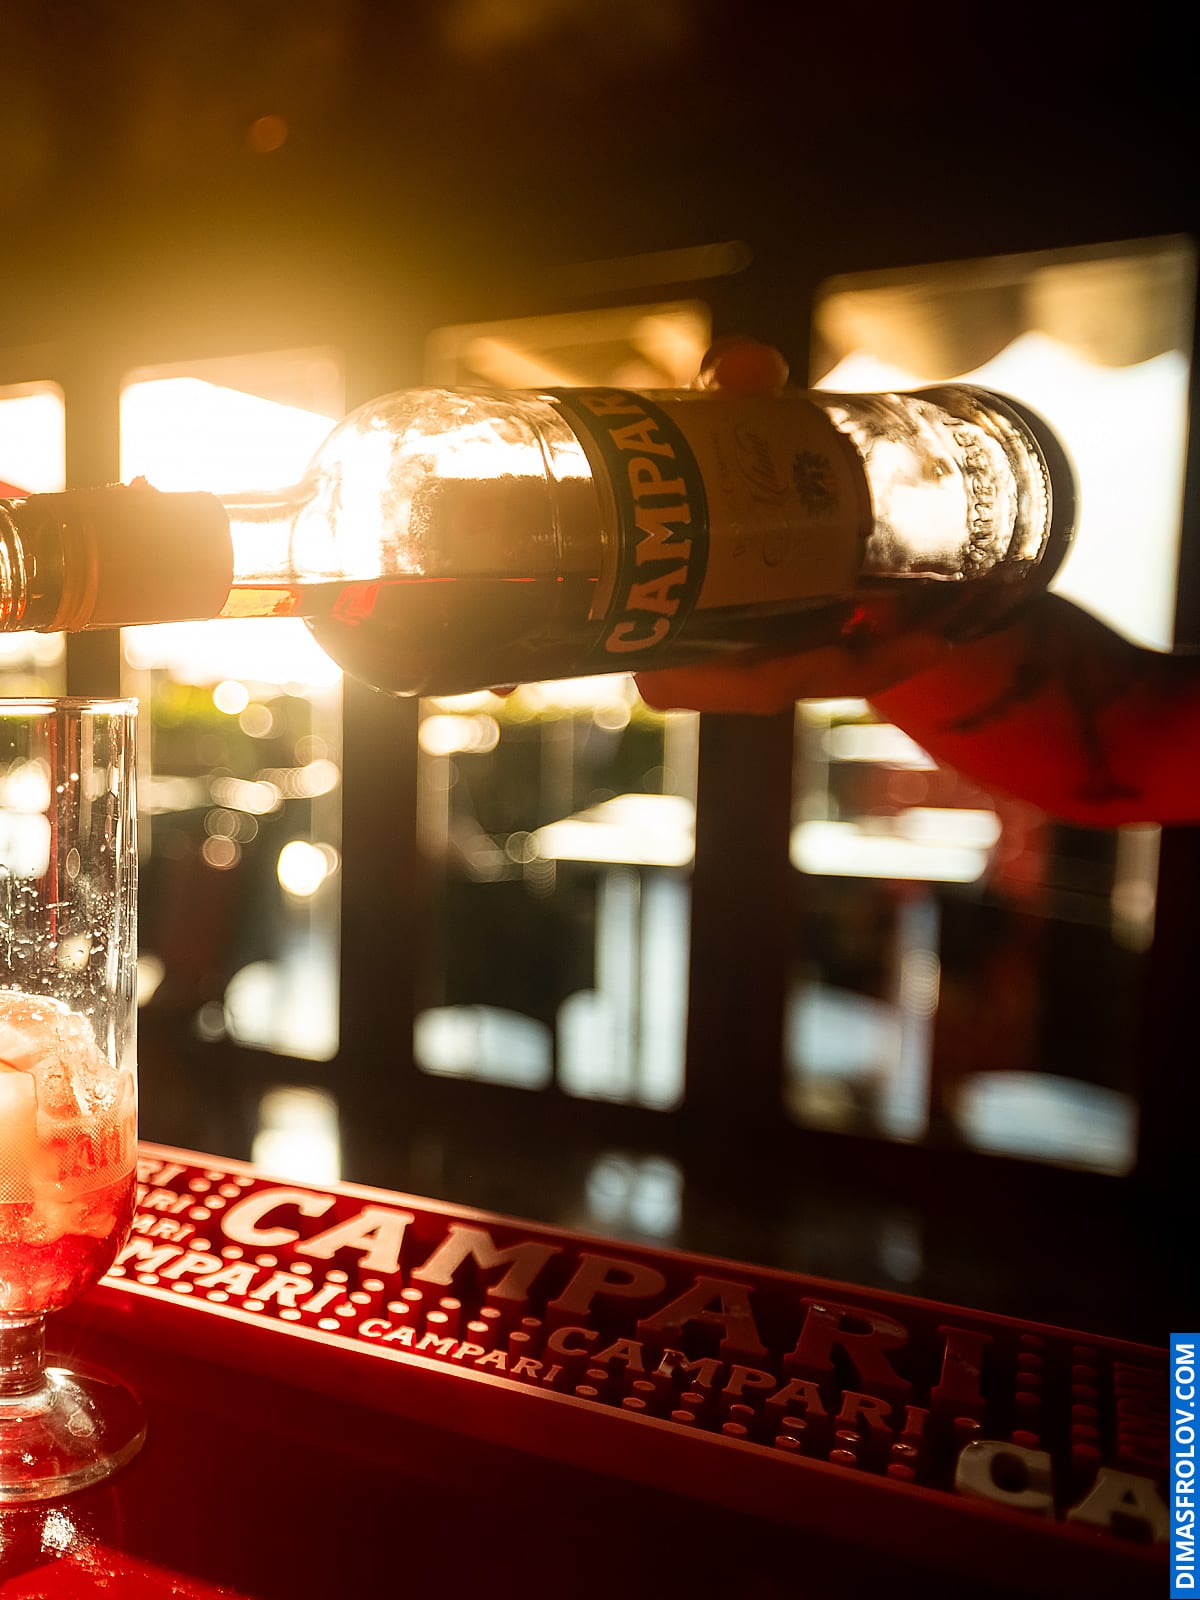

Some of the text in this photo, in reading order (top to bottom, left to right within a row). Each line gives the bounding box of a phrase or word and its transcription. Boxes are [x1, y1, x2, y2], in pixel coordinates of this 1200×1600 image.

[221, 1186, 996, 1400] CAMPARI
[357, 1317, 565, 1383] CAMPARI
[547, 1325, 931, 1436] CAMPARI
